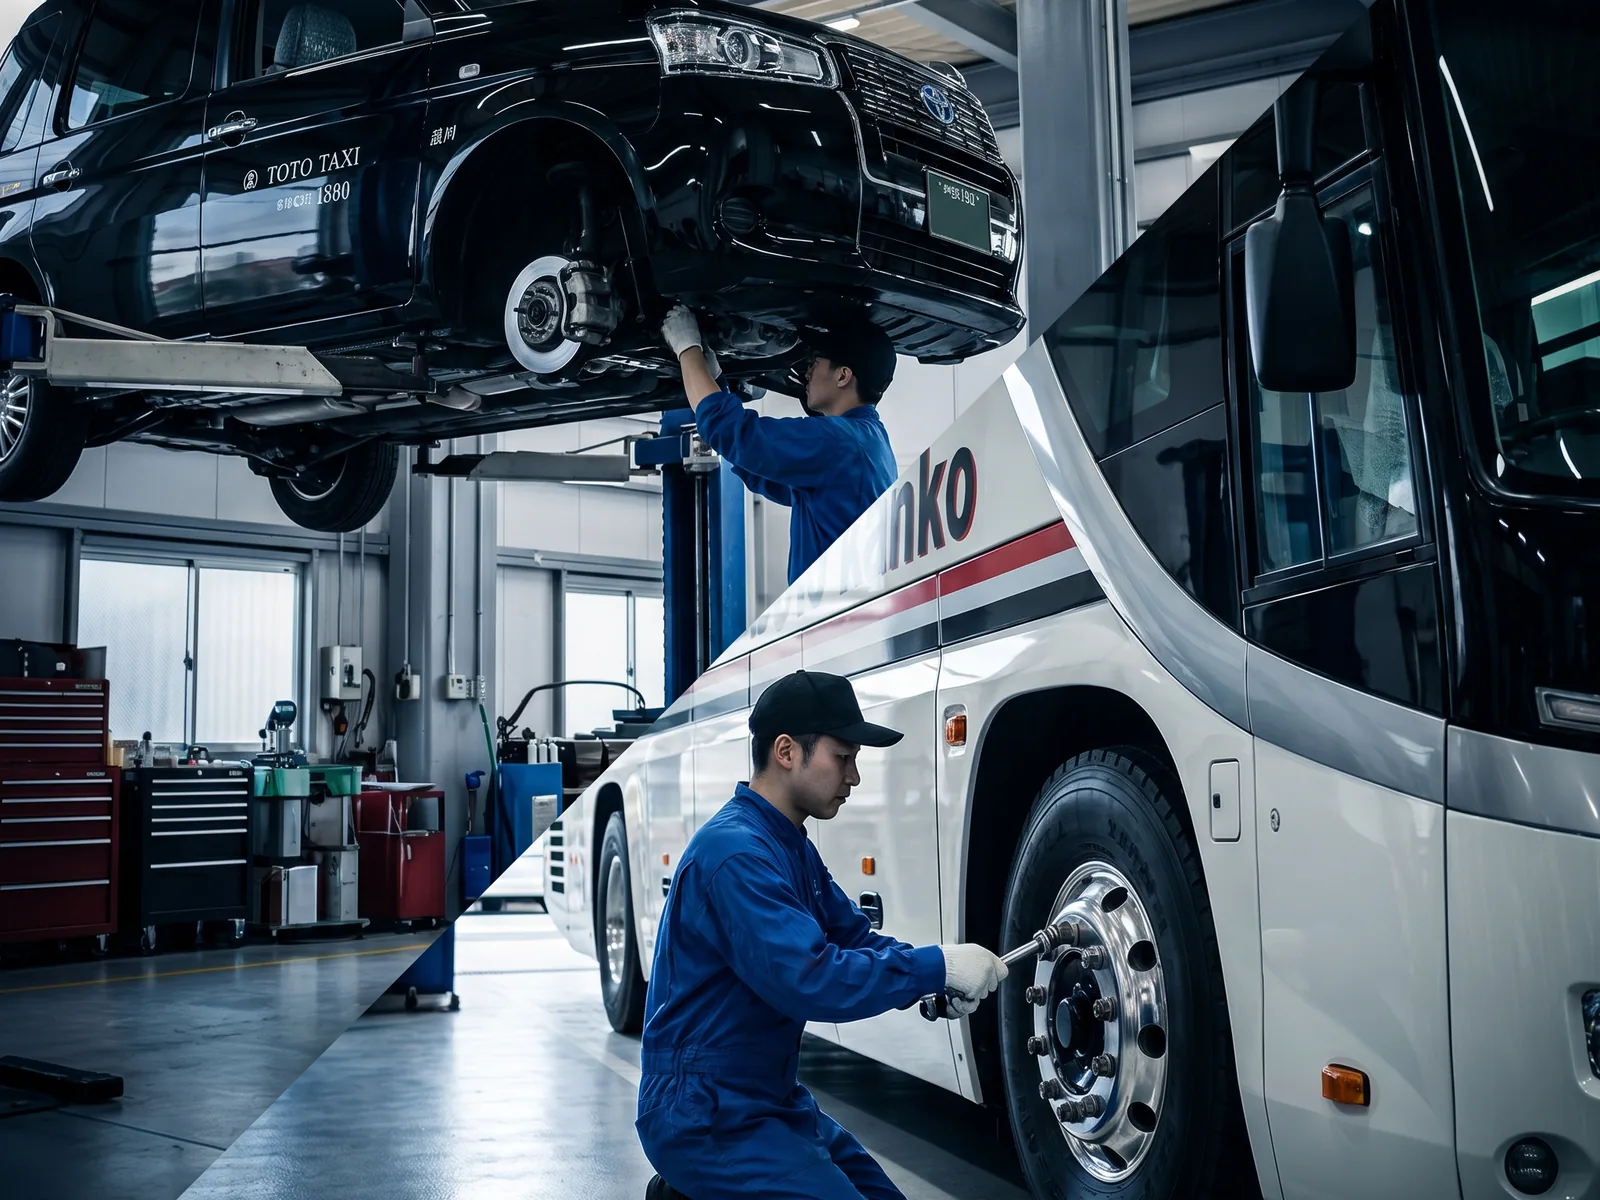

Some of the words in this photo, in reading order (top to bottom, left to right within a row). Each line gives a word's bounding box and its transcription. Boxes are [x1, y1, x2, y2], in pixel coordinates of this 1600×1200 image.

[267, 158, 314, 185] TOTO
[318, 147, 361, 174] TAXI
[317, 181, 350, 205] 1880
